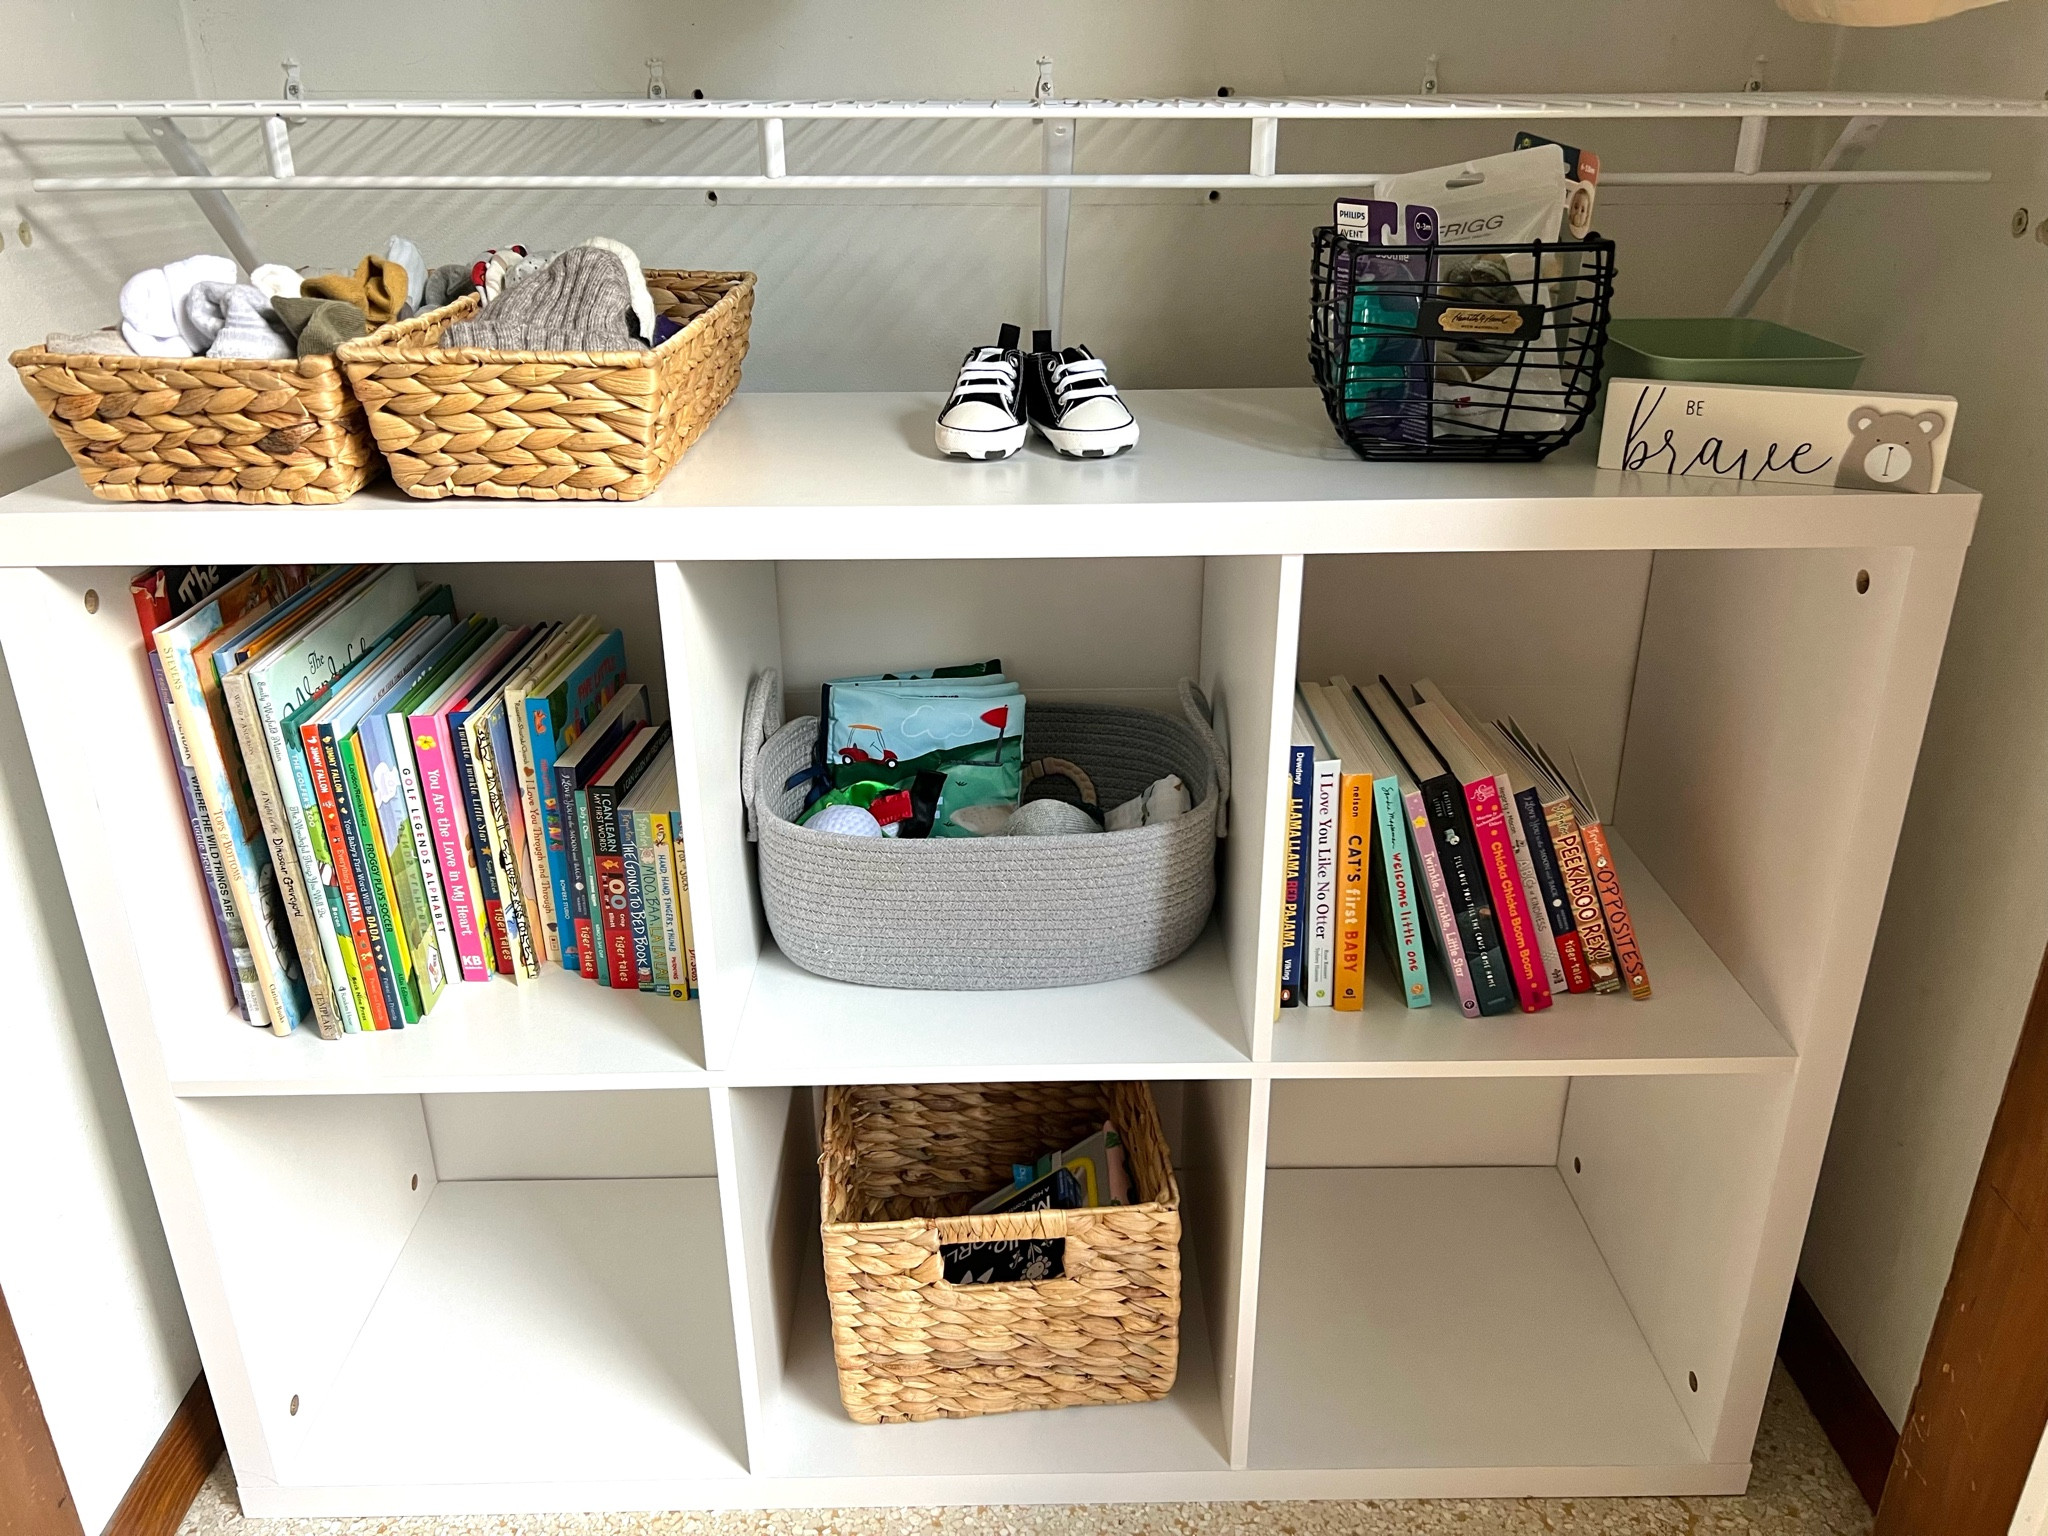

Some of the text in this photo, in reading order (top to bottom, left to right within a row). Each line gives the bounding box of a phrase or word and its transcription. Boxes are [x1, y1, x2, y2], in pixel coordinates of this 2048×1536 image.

[1339, 209, 1366, 221] PHILIPS
[1340, 228, 1364, 240] AVENT
[1685, 400, 1705, 416] BE
[1621, 386, 1833, 481] brave
[177, 565, 220, 604] The
[163, 647, 183, 691] STEVENS
[307, 650, 325, 675] The
[310, 746, 329, 794] JIMMY FALLON
[325, 745, 343, 793] JIMMY FALLON
[1293, 752, 1305, 786] Dewdney
[291, 754, 316, 828] THE GOLFER'S ZOO
[526, 785, 537, 806] Love
[1319, 782, 1334, 816] Love
[1352, 786, 1360, 818] nelson
[1499, 786, 1510, 812] Hegarty
[530, 808, 541, 826] You
[593, 793, 608, 852] MY FIRST WORDS
[602, 799, 613, 821] CAN
[191, 775, 235, 918] WHERE THE WILD THINGS ARE
[213, 809, 241, 882] TOPS BOTTOMS
[477, 824, 487, 843] Star
[532, 827, 544, 861] Through
[605, 821, 618, 853] LEARN
[635, 816, 648, 848] Boynton
[1318, 818, 1332, 845] You
[402, 768, 446, 933] GOLF LEGENDS ALPHABET
[427, 769, 472, 936] You Are the Love in My Heart
[570, 830, 582, 880] MOON BACK
[622, 840, 637, 863] THE
[657, 854, 667, 876] HAND,
[1317, 848, 1332, 878] Like
[1453, 855, 1463, 869] I'LL
[273, 837, 304, 918] Dinosaur Graveyard
[343, 819, 380, 942] Your Baby's First Word Will Be DADA
[538, 861, 547, 879] and
[624, 861, 641, 898] GOING
[642, 864, 657, 896] MOO,
[1282, 798, 1303, 948] LLAMA LLAMA RED PAJAMA
[1457, 869, 1469, 887] LOVE
[365, 843, 393, 933] FROGGY PLAYS SOCCER
[542, 880, 555, 914] Through
[559, 880, 571, 920] BOWERS STUDIO
[607, 872, 627, 910] 100
[629, 897, 643, 909] TO
[660, 876, 670, 898] HAND,
[1316, 882, 1330, 901] No
[1462, 887, 1472, 902] YOU
[1557, 834, 1599, 922] PEEKABOO
[1580, 922, 1612, 961] REX!
[332, 906, 341, 928] Bacon
[345, 892, 362, 923] MAMA
[645, 897, 660, 926] BAA,
[1343, 835, 1363, 973] CAT'S first BABY
[1392, 852, 1419, 972] welcome little one
[1424, 850, 1465, 978] Twinkle, Twinkle, Little Star
[1466, 902, 1477, 918] TILL
[1490, 841, 1534, 981] Chicka Chicka Boom Boom
[1530, 893, 1547, 933] KINDNESS
[494, 908, 513, 960] tiger tales
[631, 909, 646, 935] BED
[650, 926, 664, 943] LA
[1315, 903, 1330, 940] Otter
[1471, 918, 1481, 931] THE
[1596, 869, 1644, 977] OPPOSITES
[580, 926, 594, 973] tiger tales
[634, 935, 649, 966] BOOK
[652, 944, 666, 961] LA
[666, 928, 676, 952] THUMB
[1475, 931, 1486, 951] COWS
[461, 955, 483, 966] KB
[615, 935, 629, 983] tiger tales
[1282, 958, 1292, 981] Viking
[1480, 951, 1492, 969] COME
[1564, 939, 1584, 985] tiger tales
[351, 976, 360, 991] Back
[1485, 970, 1497, 989] HOME
[315, 991, 333, 1032] TEMPLAR
